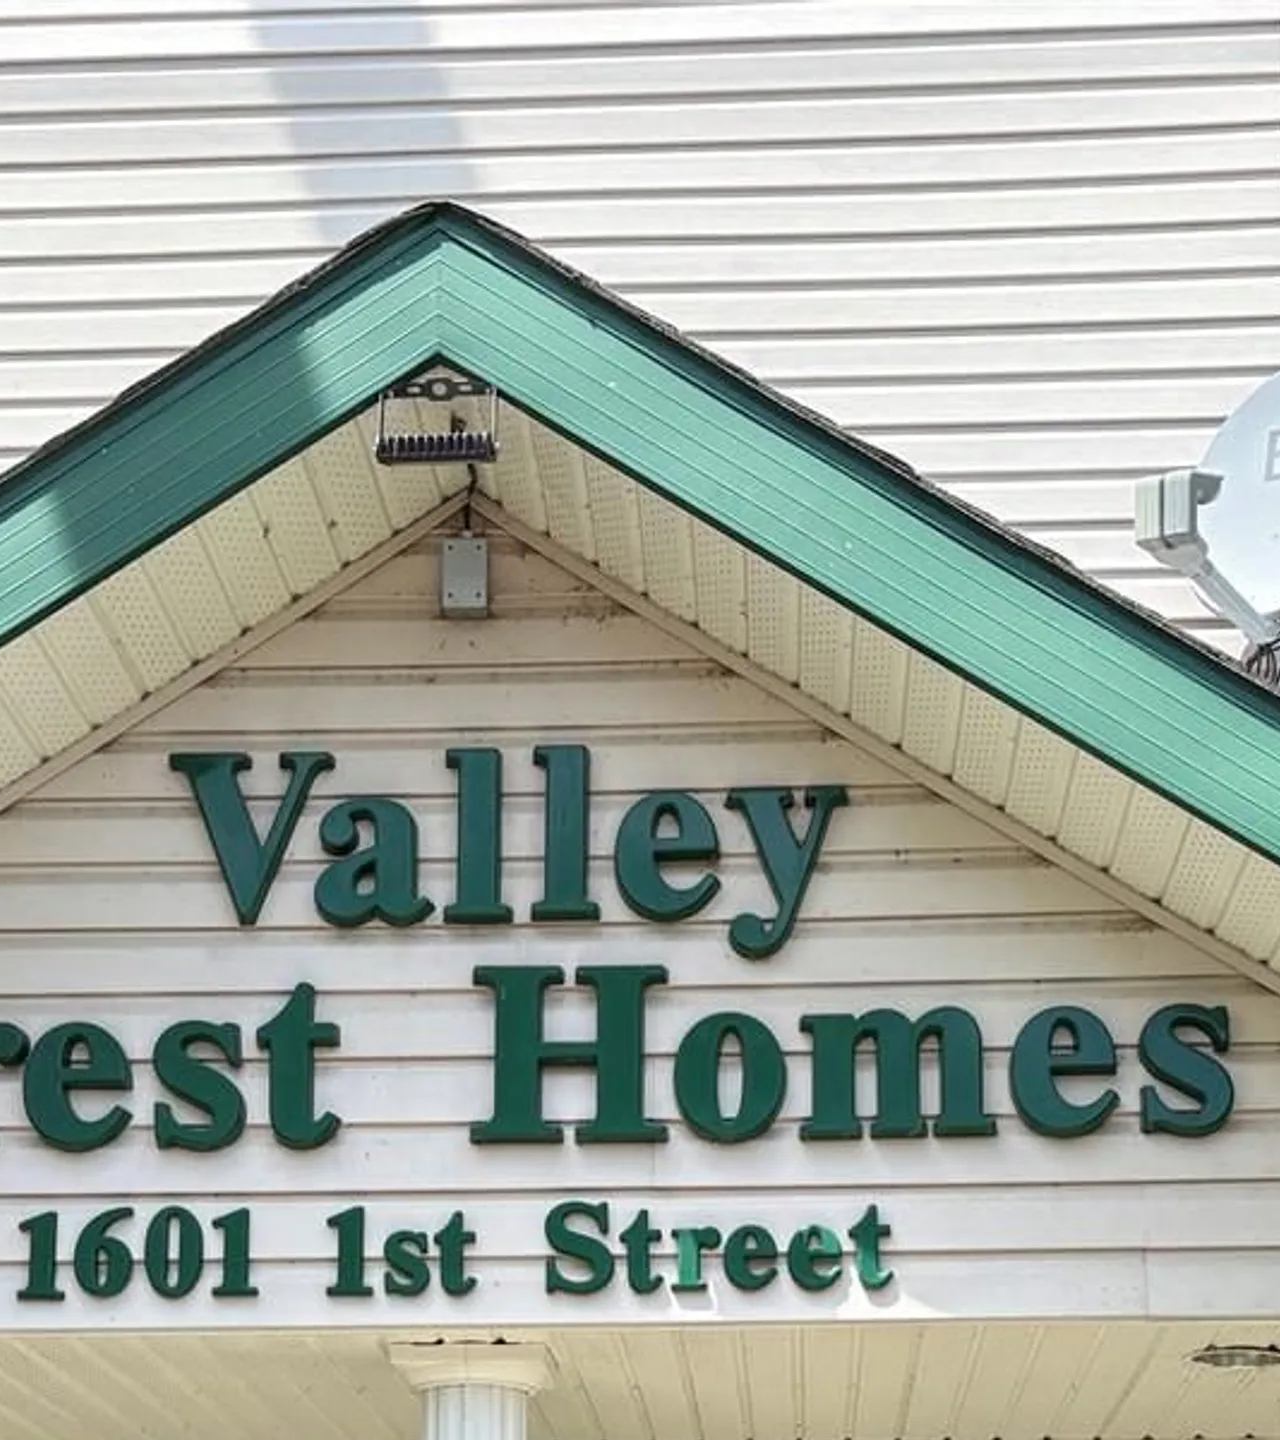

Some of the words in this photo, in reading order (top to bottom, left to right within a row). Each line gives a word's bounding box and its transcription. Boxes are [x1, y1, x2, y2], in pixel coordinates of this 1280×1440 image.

[169, 744, 849, 960] Valley
[470, 965, 1235, 1145] Homes
[17, 1206, 260, 1302] 1601
[326, 1206, 477, 1297] 1st
[544, 1202, 893, 1295] Street
